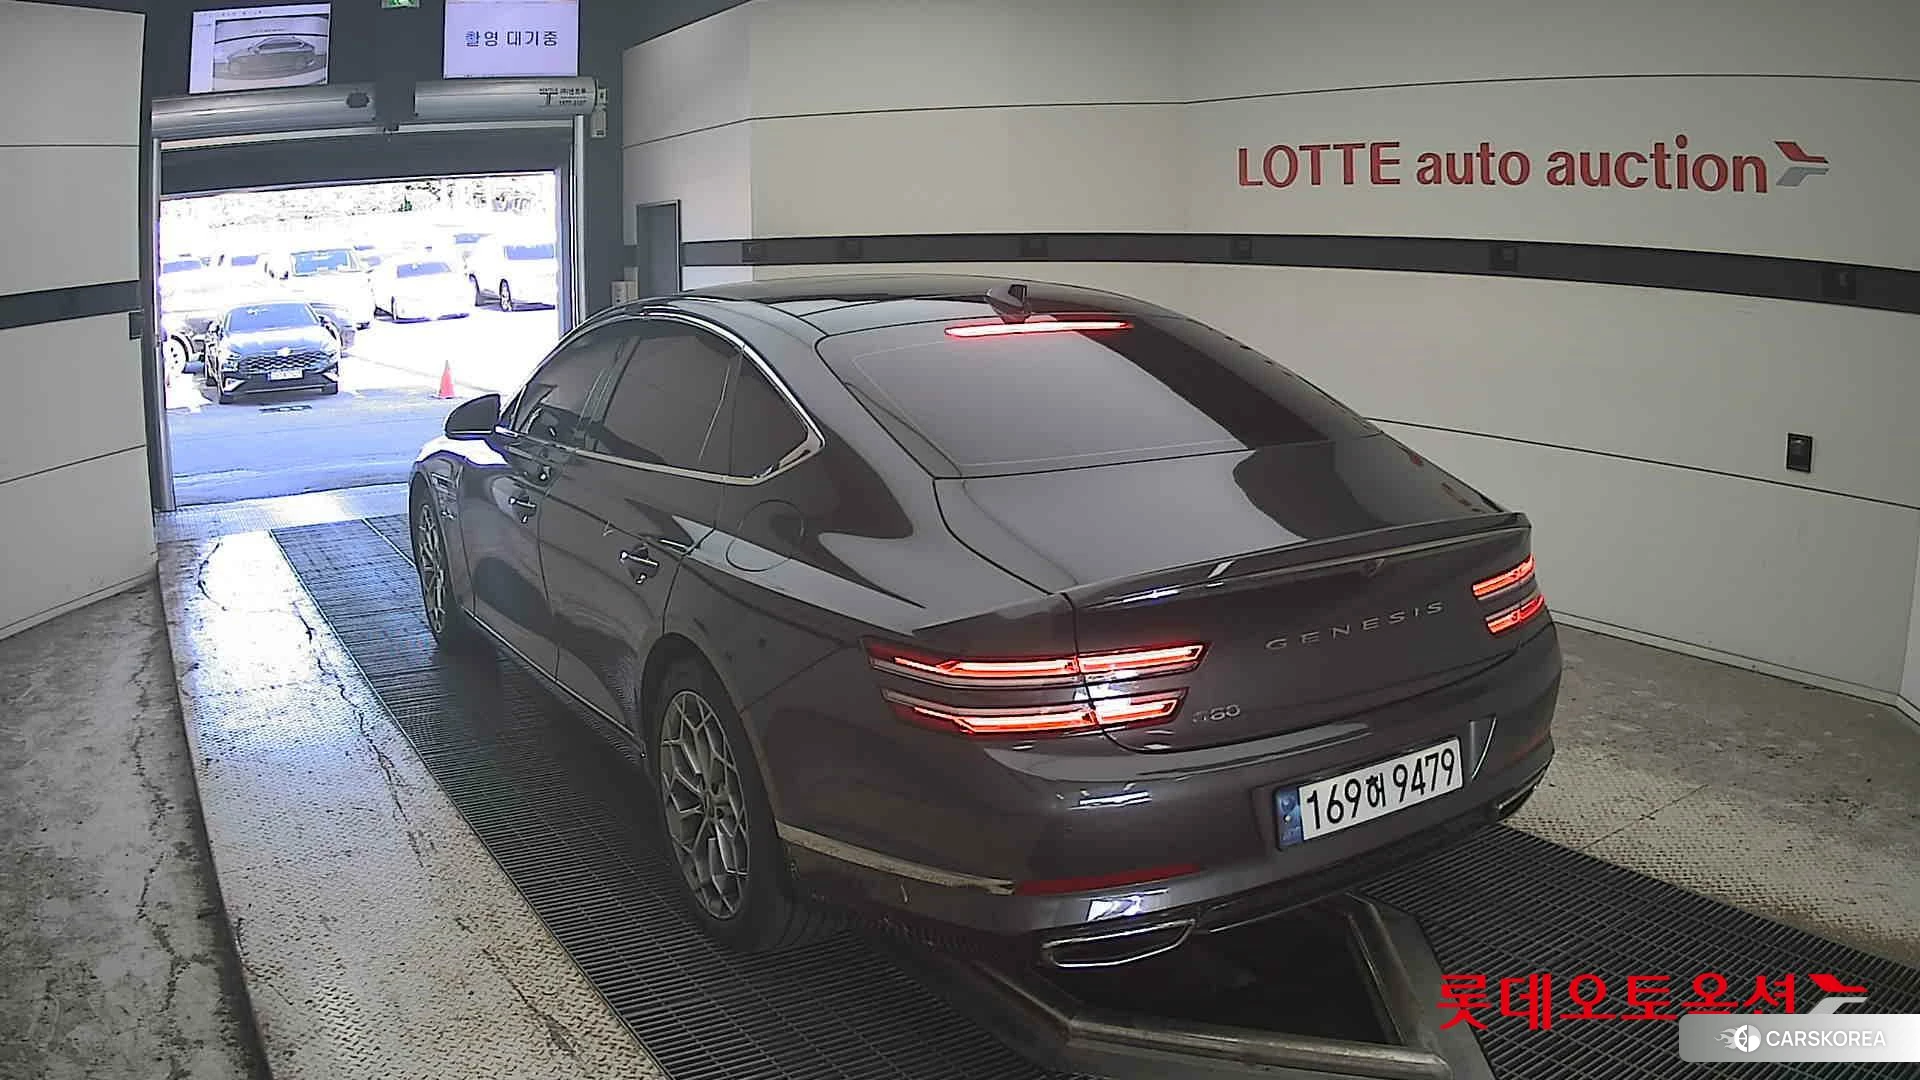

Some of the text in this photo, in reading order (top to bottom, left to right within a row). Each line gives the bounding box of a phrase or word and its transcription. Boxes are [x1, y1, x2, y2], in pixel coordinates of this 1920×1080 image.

[506, 30, 558, 47] 대기중
[1238, 134, 1768, 193] LOTTE auto auction
[1264, 601, 1444, 650] GENESIS
[1306, 748, 1455, 830] 169허 9479
